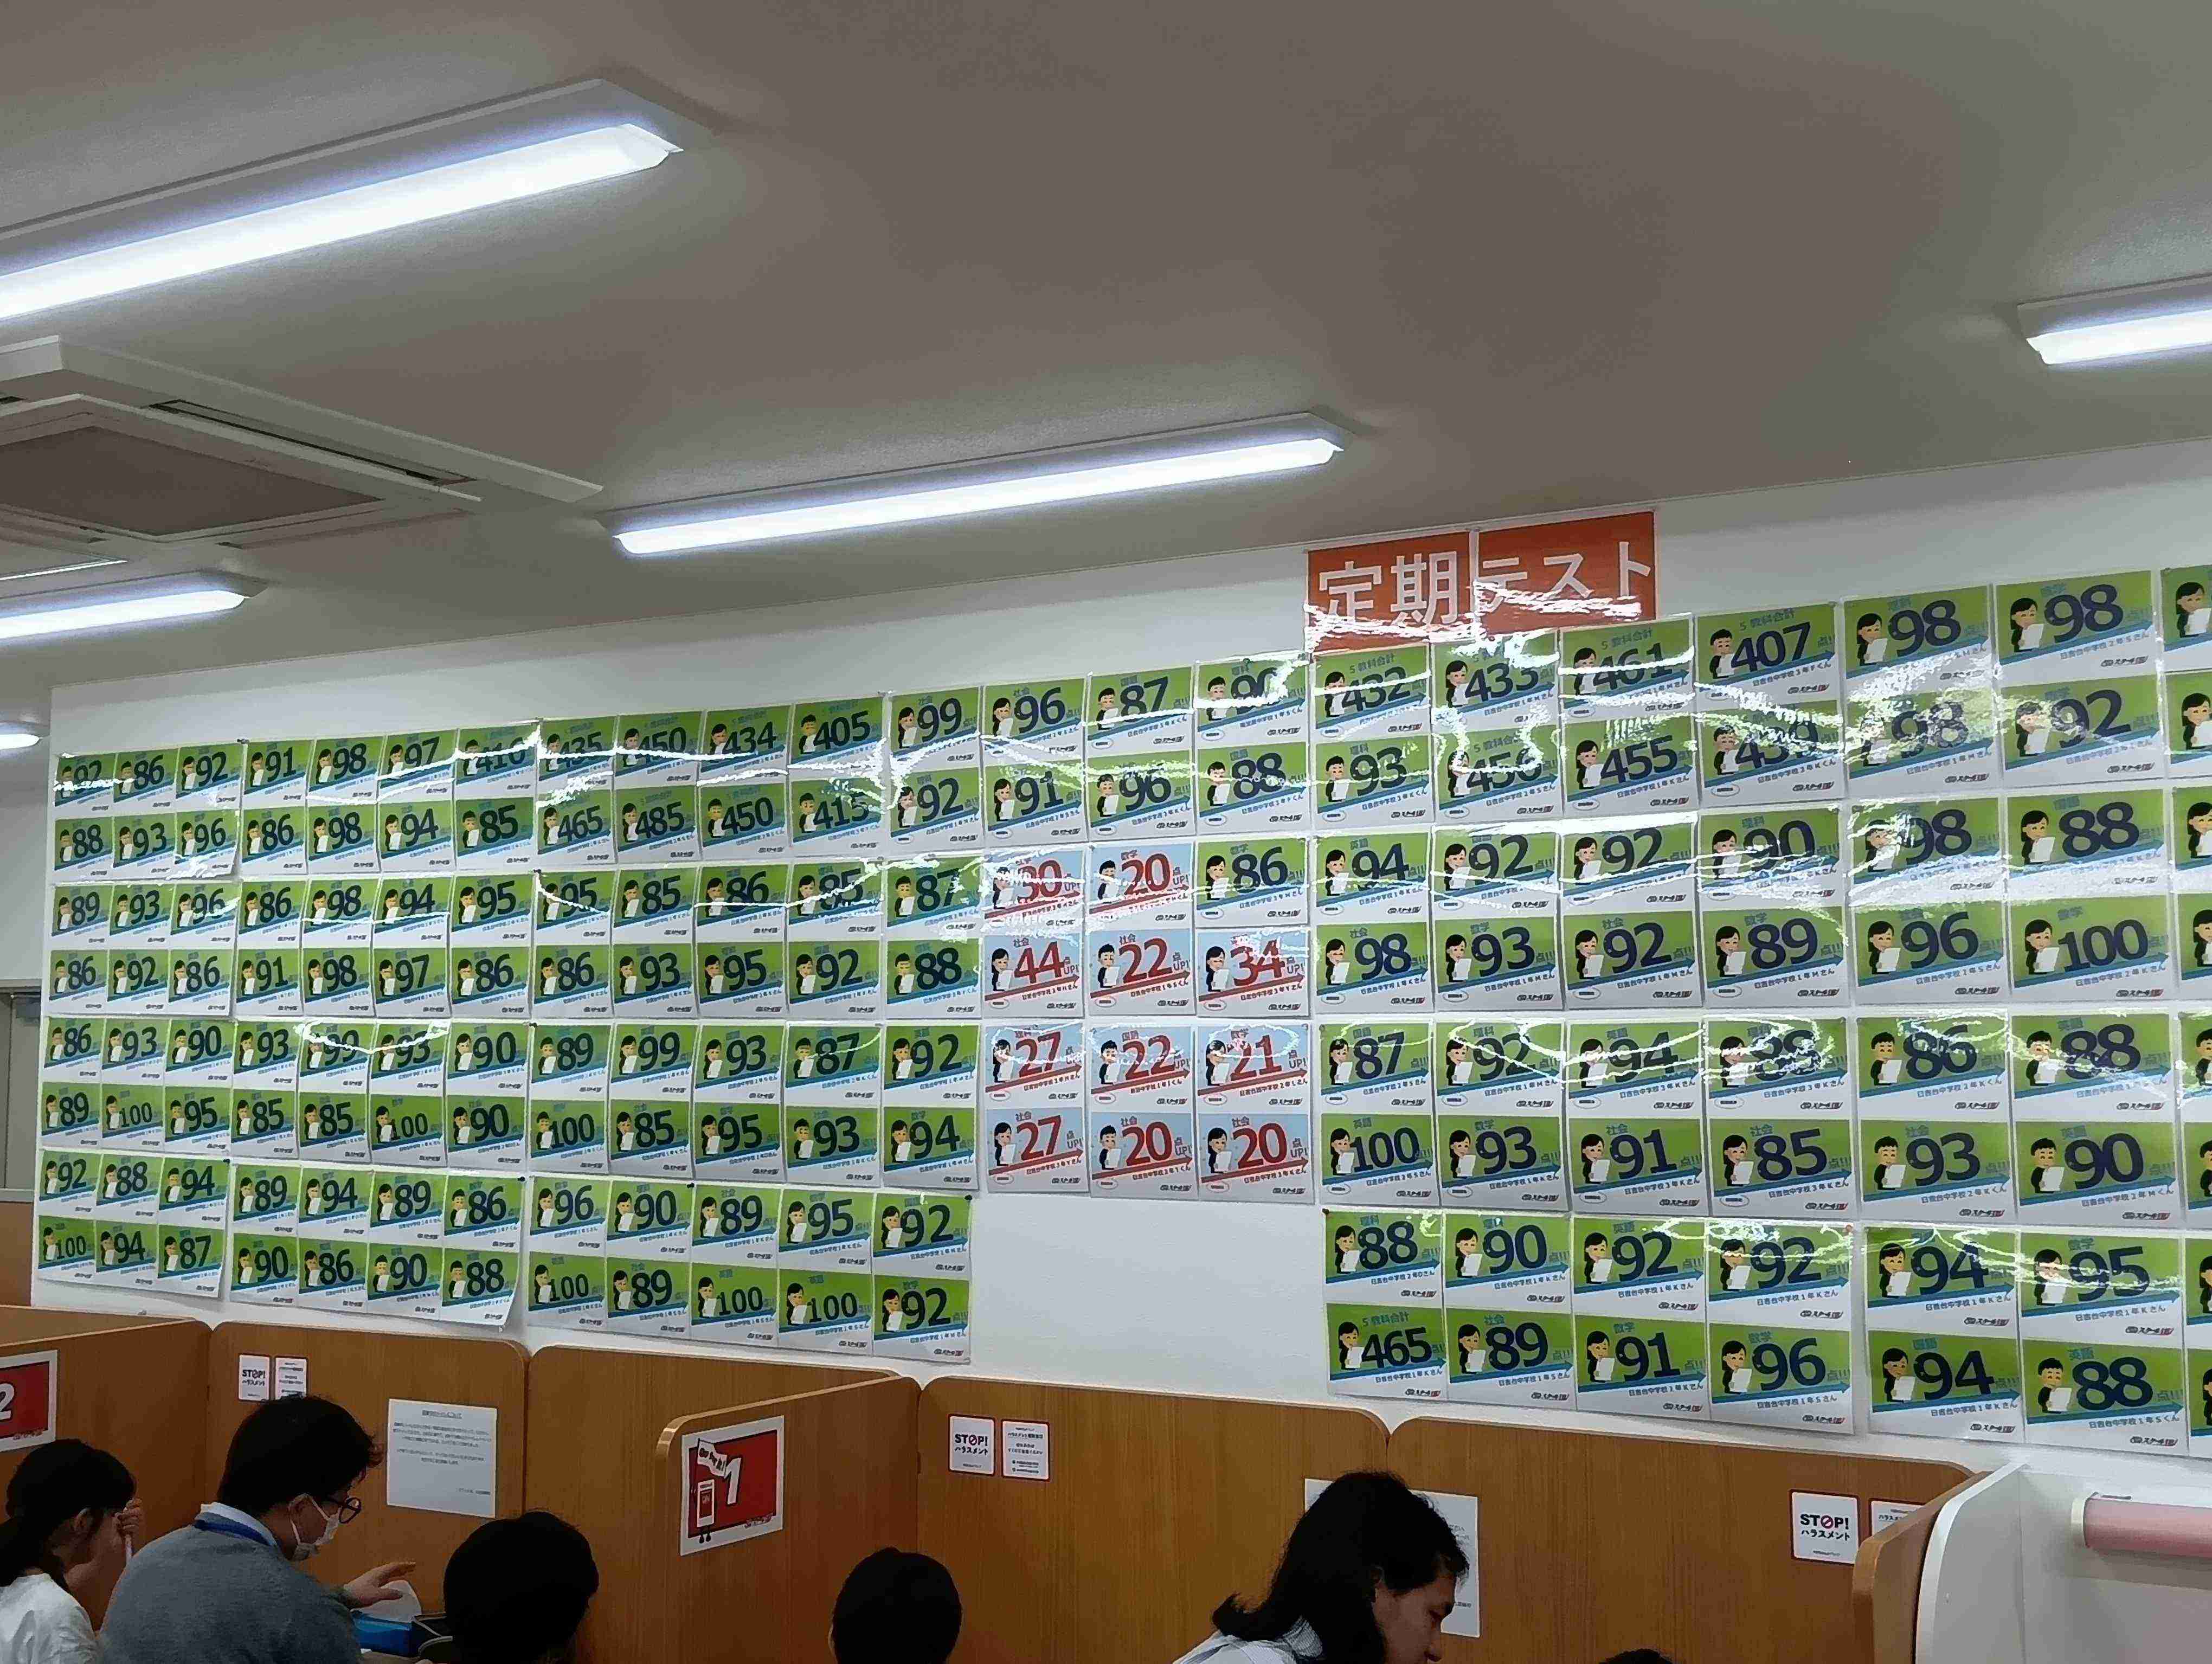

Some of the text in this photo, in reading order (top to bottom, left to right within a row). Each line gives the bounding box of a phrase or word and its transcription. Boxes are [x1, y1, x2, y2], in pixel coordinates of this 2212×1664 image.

[1888, 600, 1961, 656] 98
[2044, 584, 2123, 643] 98
[1731, 622, 1811, 672] 407
[1014, 687, 1065, 733] 96
[1120, 676, 1168, 722] 87
[813, 710, 871, 750] 405
[918, 698, 961, 741] 99
[196, 751, 228, 786] 92
[266, 747, 296, 782] 91
[1231, 753, 1286, 799] 88
[1350, 747, 1406, 796] 93
[1601, 736, 1677, 783] 455
[917, 778, 963, 821] 92
[1014, 772, 1063, 815] 91
[261, 814, 294, 848] 86
[328, 812, 362, 849] 98
[401, 808, 439, 846] 94
[479, 805, 518, 843] 85
[557, 805, 603, 841] 465
[636, 801, 685, 838] 485
[721, 797, 774, 833] 450
[2059, 802, 2139, 857] 88
[195, 818, 226, 852] 96
[1602, 828, 1667, 875] 92
[1232, 847, 1288, 894] 86
[1352, 843, 1409, 891] 94
[1469, 836, 1533, 885] 92
[72, 892, 100, 926] 89
[130, 890, 160, 923] 93
[260, 887, 292, 921] 86
[327, 885, 361, 920] 98
[400, 884, 435, 915] 94
[477, 881, 516, 919] 95
[642, 876, 681, 916] 85
[1355, 933, 1411, 980] 98
[1471, 927, 1535, 976] 93
[1603, 922, 1671, 973] 92
[1748, 918, 1817, 969] 89
[1901, 912, 1978, 968] 96
[2059, 920, 2148, 972] 100
[68, 956, 96, 990] 86
[127, 956, 158, 991] 92
[187, 956, 220, 992] 86
[256, 956, 288, 989] 91
[323, 955, 357, 992] 98
[395, 955, 430, 992] 97
[475, 954, 514, 992] 86
[557, 952, 594, 991] 86
[640, 952, 680, 991] 93
[723, 949, 766, 992] 95
[816, 949, 863, 992] 92
[915, 948, 962, 990] 88
[1014, 941, 1065, 984] 44
[1119, 938, 1172, 984] 22
[65, 1024, 91, 1057] 86
[123, 1027, 156, 1059] 93
[189, 1026, 221, 1060] 90
[258, 1029, 288, 1063] 93
[473, 1032, 517, 1069] 90
[557, 1032, 594, 1071] 89
[638, 1032, 680, 1071] 99
[815, 1033, 859, 1074] 87
[910, 1034, 962, 1078] 92
[1355, 1031, 1404, 1080] 87
[2061, 1024, 2140, 1080] 88
[60, 1093, 89, 1127] 89
[120, 1103, 152, 1127] 100
[184, 1097, 217, 1132] 95
[253, 1098, 284, 1133] 85
[319, 1102, 353, 1136] 85
[470, 1104, 509, 1139] 90
[634, 1110, 675, 1148] 85
[551, 1114, 595, 1147] 100
[719, 1115, 762, 1153] 95
[814, 1116, 860, 1157] 93
[909, 1115, 960, 1159] 94
[1017, 1115, 1061, 1160] 27
[1122, 1121, 1174, 1166] 20
[1232, 1122, 1287, 1168] 20
[1349, 1128, 1419, 1172] 100
[1476, 1126, 1536, 1174] 93
[1610, 1129, 1677, 1179] 91
[1754, 1128, 1827, 1181] 85
[1906, 1133, 1980, 1186] 93
[2065, 1133, 2144, 1188] 90
[58, 1159, 87, 1192] 92
[182, 1166, 214, 1197] 94
[255, 1175, 287, 1211] 89
[323, 1178, 358, 1217] 94
[395, 1180, 431, 1218] 89
[555, 1186, 594, 1224] 96
[634, 1191, 676, 1229] 90
[721, 1195, 763, 1236] 89
[808, 1199, 854, 1240] 95
[901, 1205, 954, 1247] 92
[56, 1236, 86, 1260] 100
[114, 1231, 145, 1262] 94
[181, 1236, 211, 1270] 87
[255, 1247, 288, 1282] 90
[1358, 1221, 1418, 1269] 88
[1483, 1225, 1547, 1274] 90
[1612, 1231, 1678, 1282] 92
[1750, 1237, 1822, 1288] 92
[319, 1250, 353, 1284] 86
[390, 1254, 427, 1290] 90
[466, 1258, 504, 1296] 88
[1911, 1244, 1989, 1295] 94
[2069, 1247, 2149, 1302] 95
[550, 1274, 588, 1301] 100
[632, 1269, 672, 1310] 89
[716, 1287, 763, 1315] 100
[809, 1293, 858, 1322] 100
[901, 1288, 950, 1328] 92
[1362, 1327, 1432, 1369] 465
[1486, 1322, 1548, 1370] 89
[1615, 1332, 1681, 1382] 91
[1752, 1338, 1826, 1391] 96
[1914, 1351, 1995, 1400] 94
[2073, 1357, 2153, 1410] 88
[955, 1434, 988, 1446] STOP!
[1801, 1514, 1849, 1530] STOP!
[1802, 1530, 1850, 1541] ハラスメント
